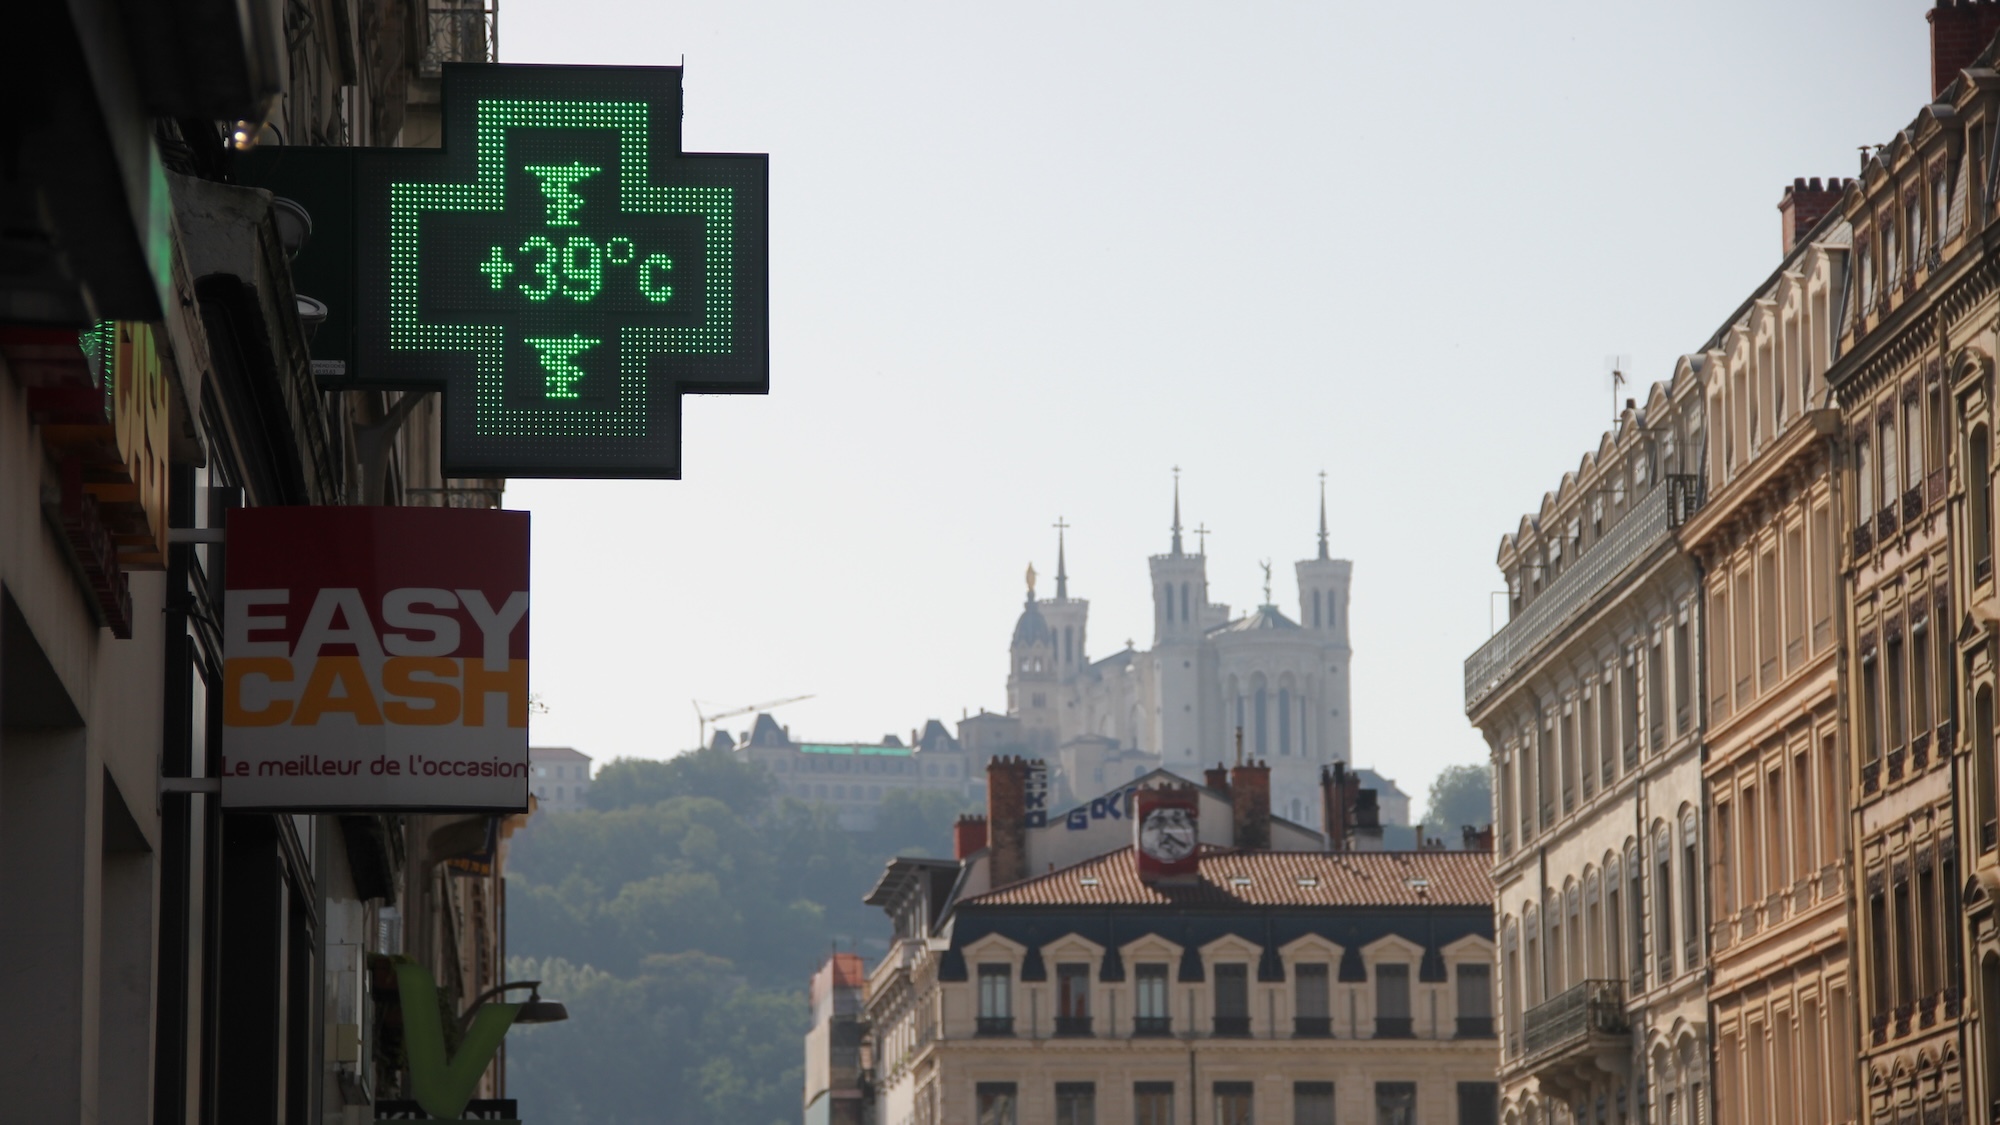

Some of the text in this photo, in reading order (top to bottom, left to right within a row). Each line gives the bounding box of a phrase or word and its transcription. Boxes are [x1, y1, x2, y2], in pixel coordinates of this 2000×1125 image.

[223, 587, 529, 672] EASY
[223, 656, 529, 728] CASH
[222, 755, 528, 778] Le meilleur de l'occasion
